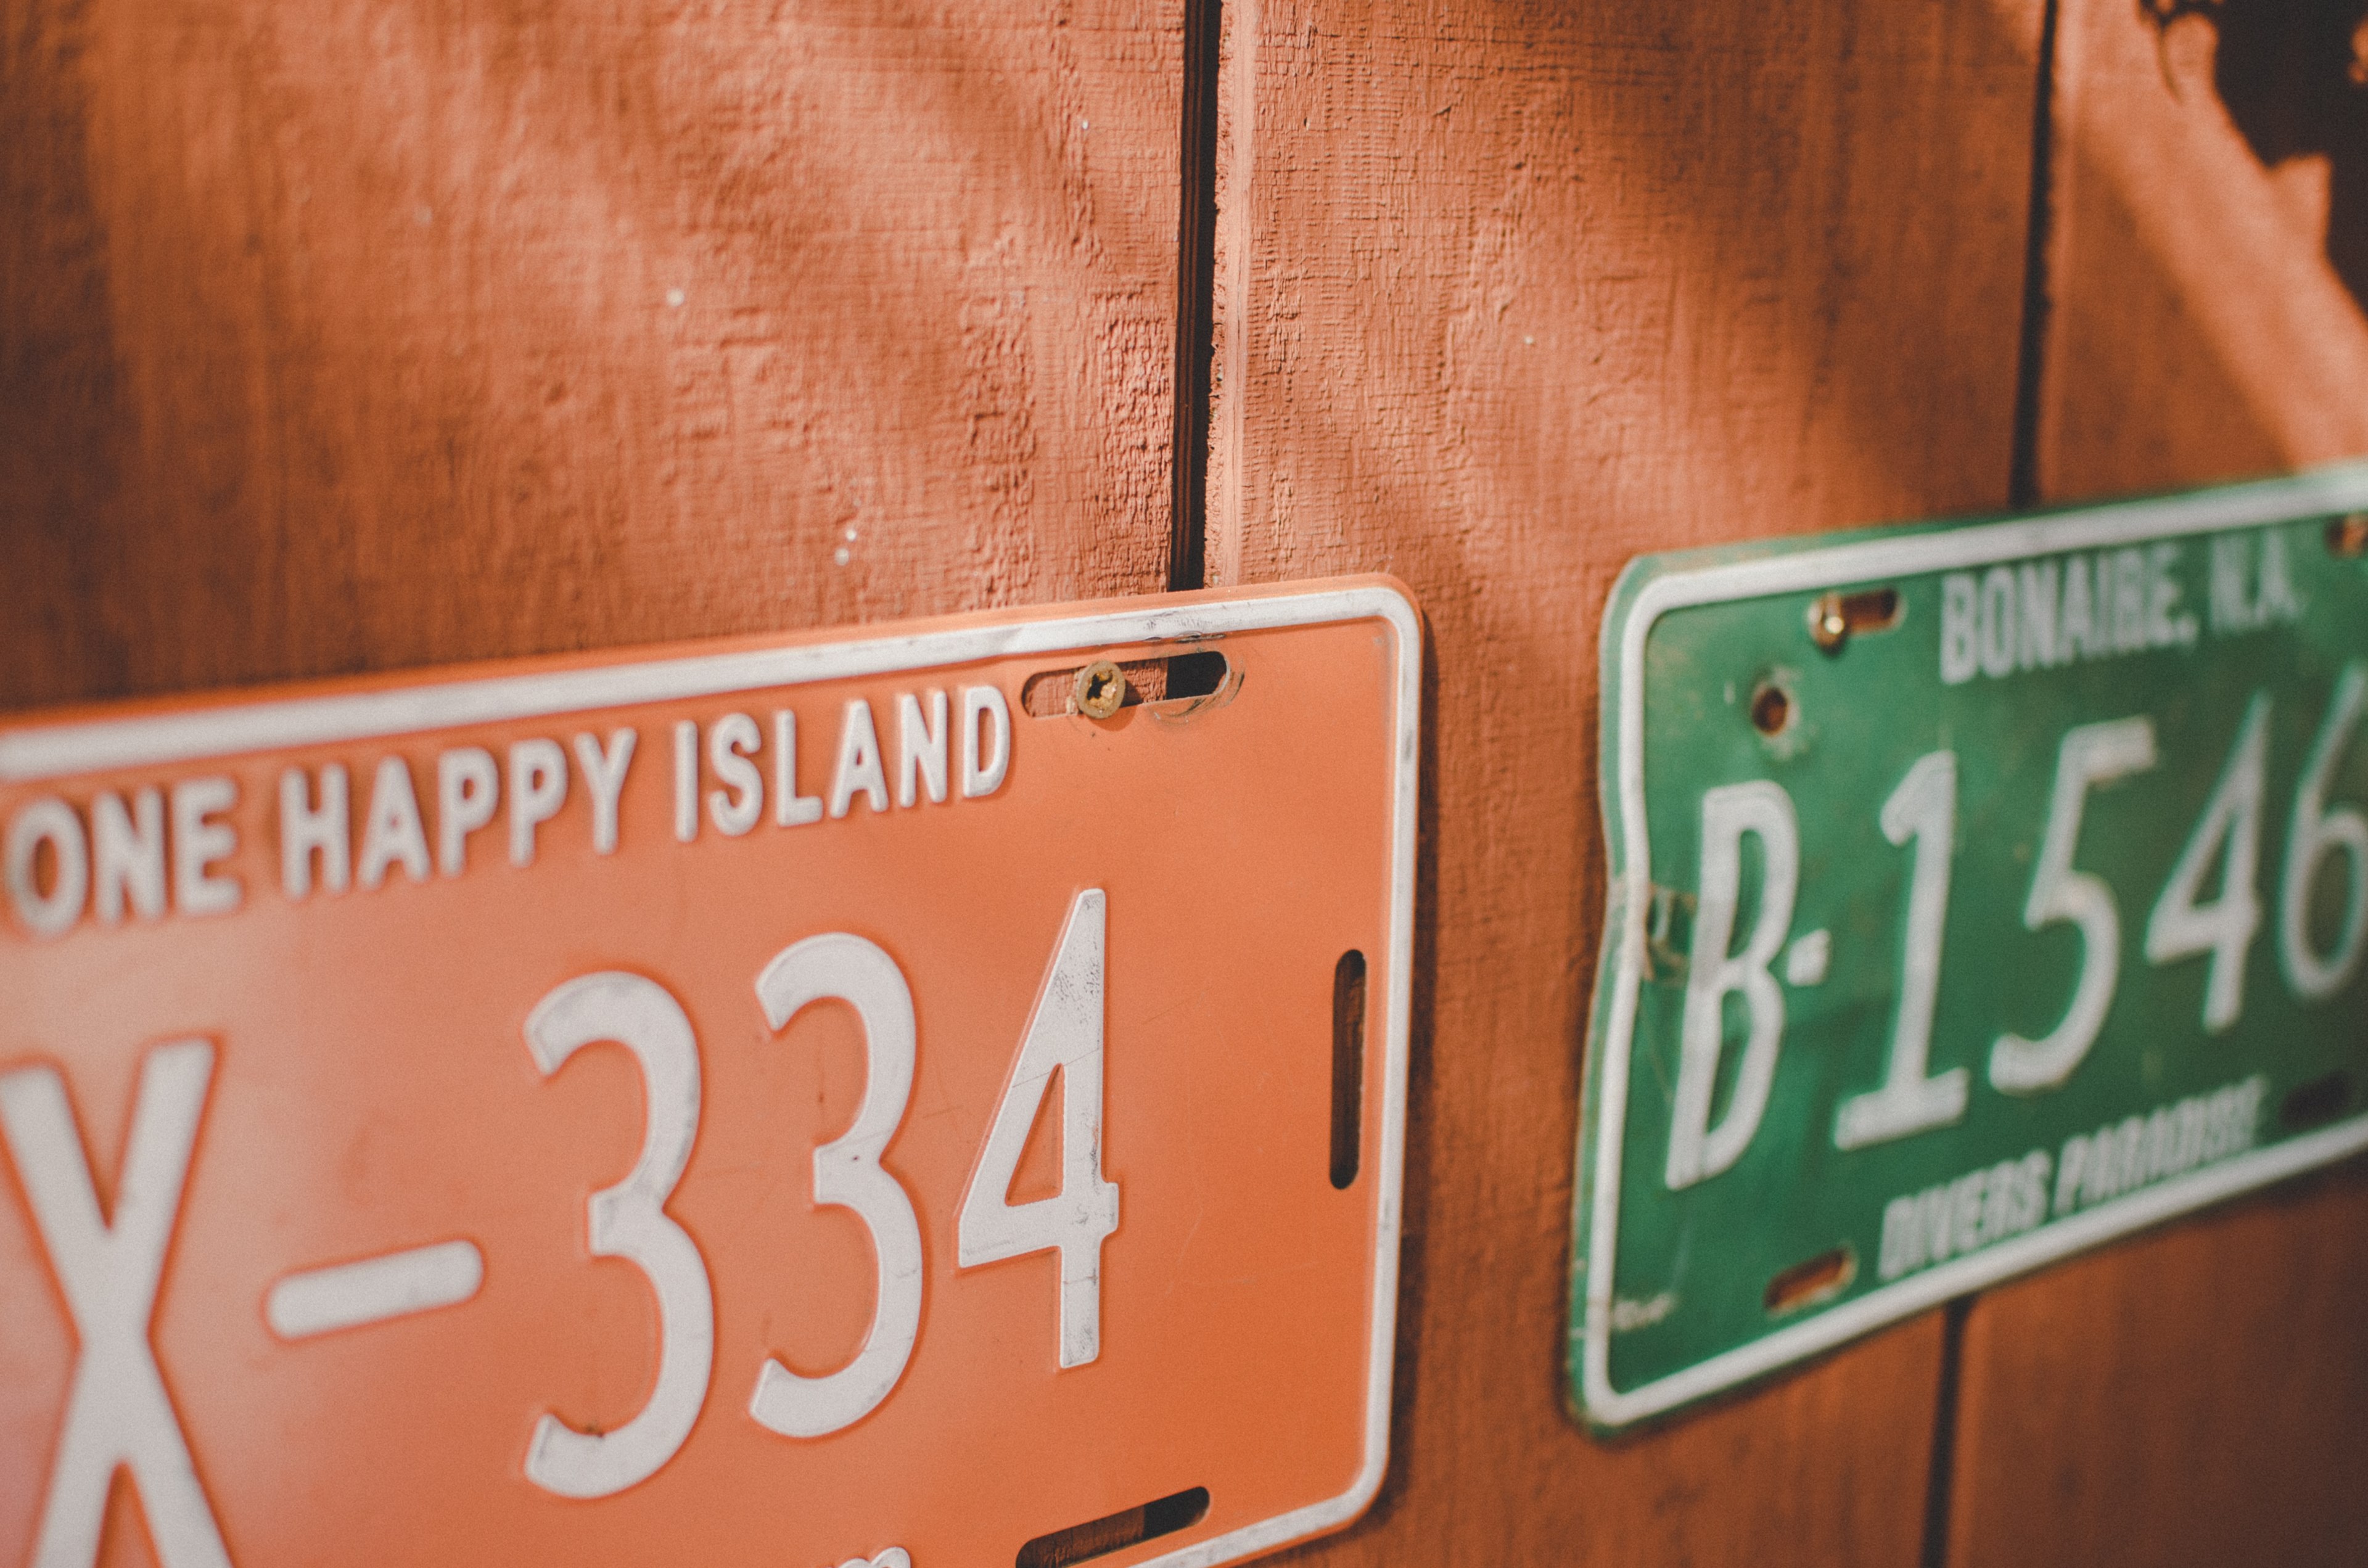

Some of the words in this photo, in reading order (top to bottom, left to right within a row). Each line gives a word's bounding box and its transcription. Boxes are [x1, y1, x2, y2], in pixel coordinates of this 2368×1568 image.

[5, 775, 242, 940] ONE
[279, 727, 638, 900] HAPPY
[673, 684, 1011, 844] ISLAND
[0, 886, 1120, 1568] X-334
[1878, 1149, 2054, 1283] DIVERS
